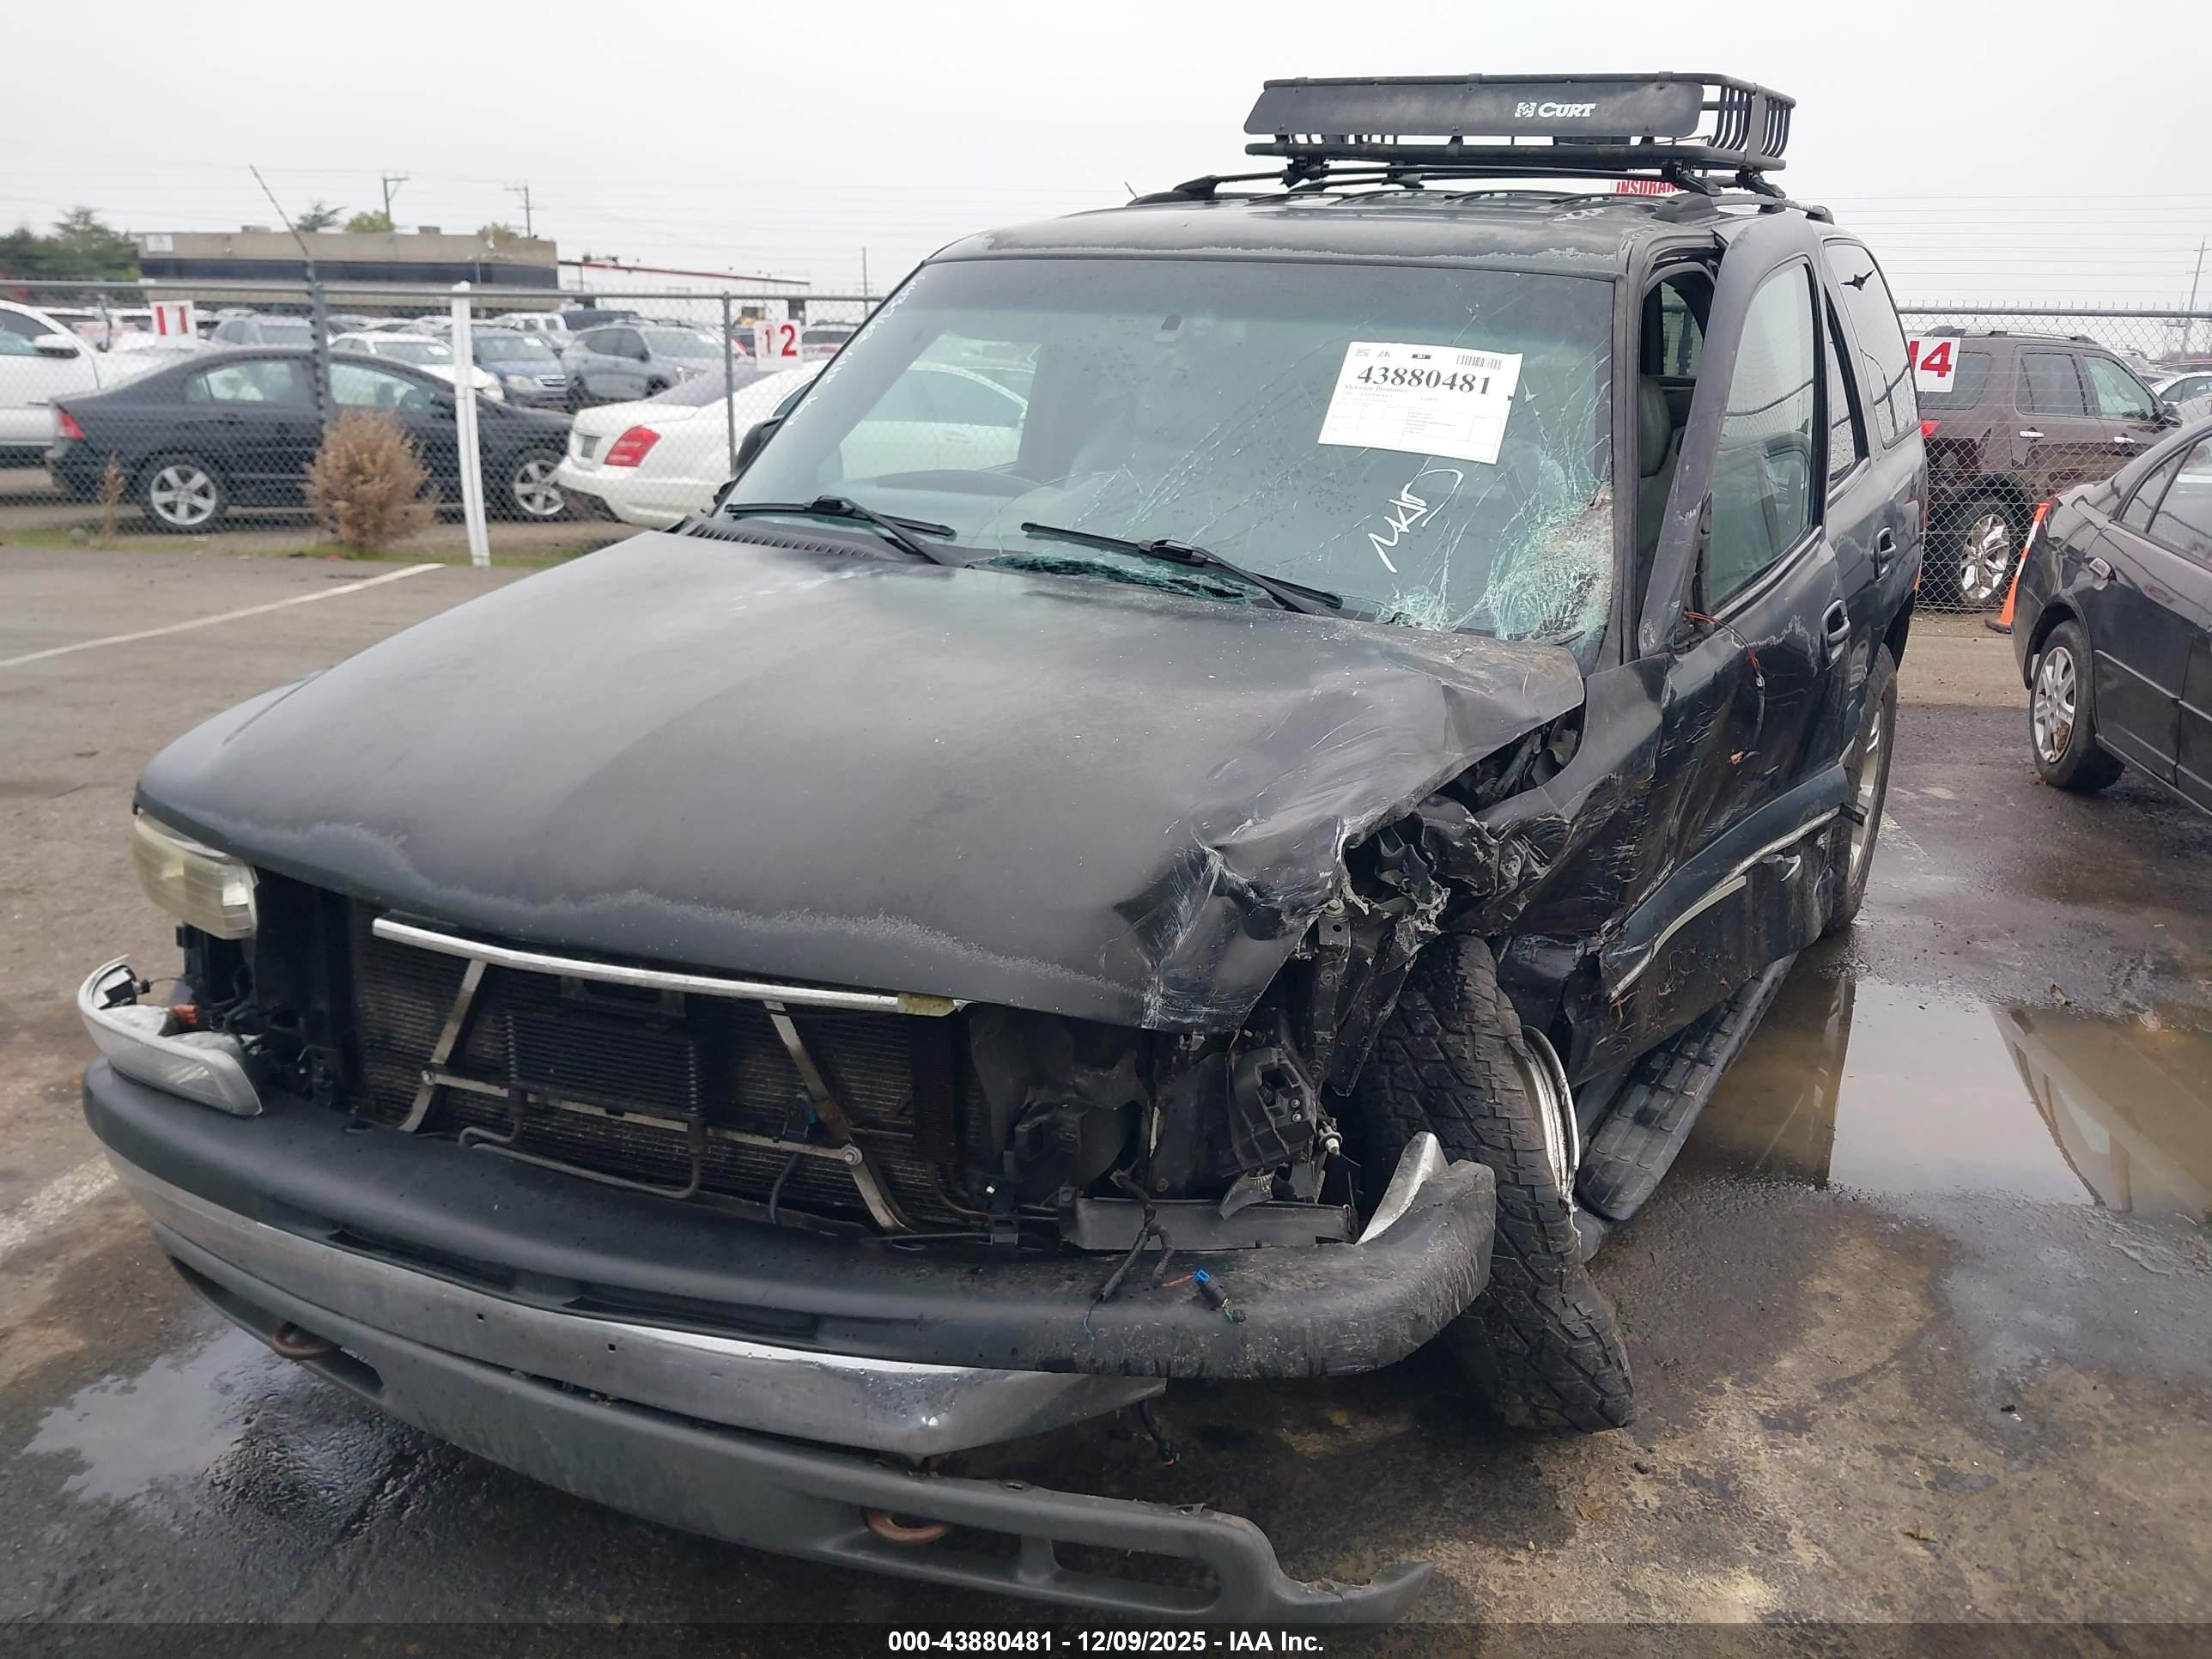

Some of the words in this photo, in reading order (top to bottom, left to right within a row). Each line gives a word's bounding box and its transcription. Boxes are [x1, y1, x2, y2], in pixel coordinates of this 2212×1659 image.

[1538, 102, 1596, 118] CURT
[1616, 178, 1684, 195] INSURAN
[155, 306, 189, 336] 11
[763, 325, 797, 357] 12
[1909, 341, 1953, 378] 14
[1357, 365, 1492, 397] 43880481
